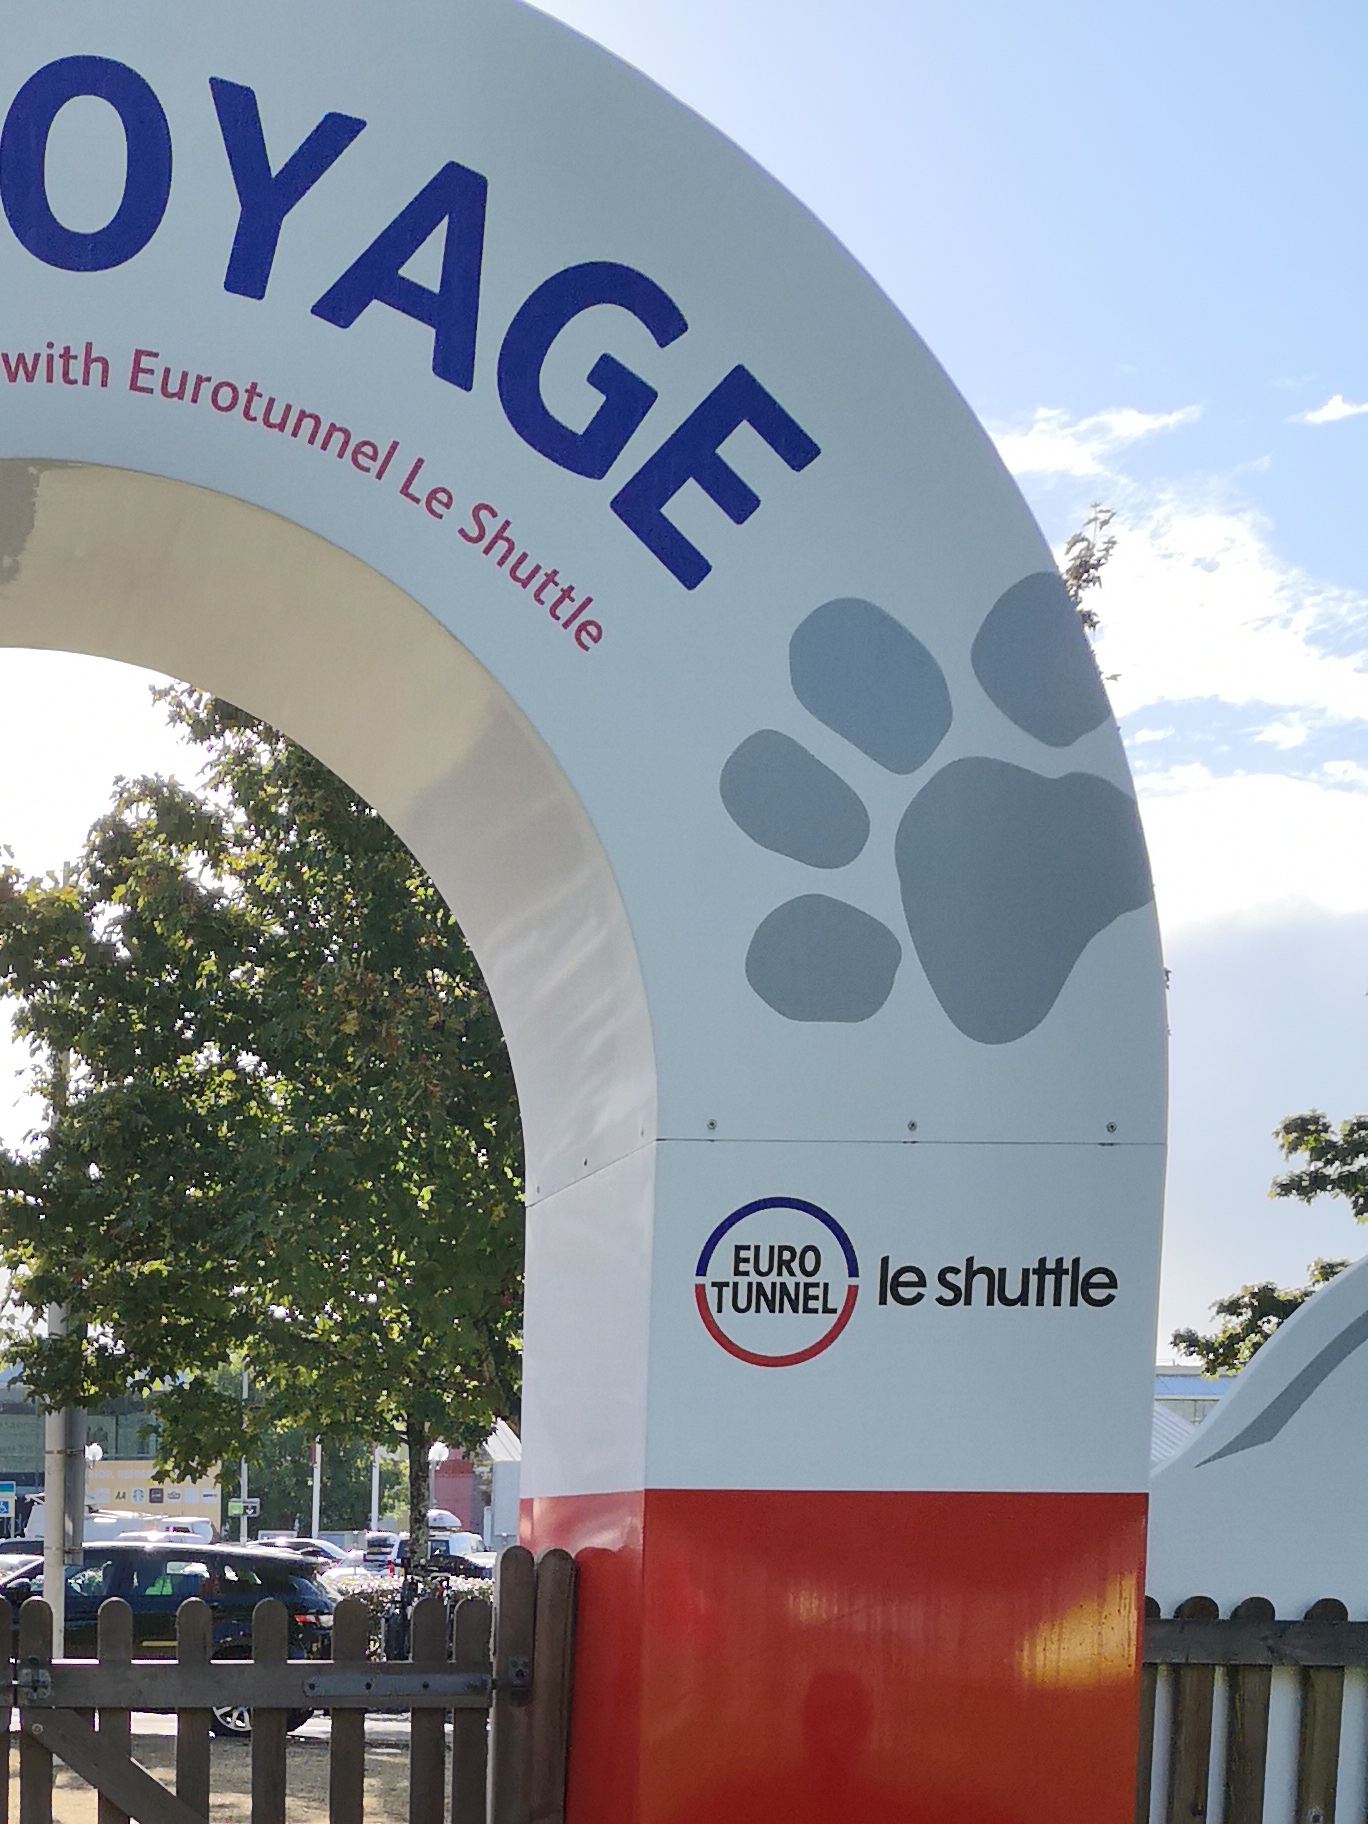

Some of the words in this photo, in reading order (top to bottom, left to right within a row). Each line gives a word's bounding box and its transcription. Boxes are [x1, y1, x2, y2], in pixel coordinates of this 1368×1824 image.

[1, 342, 110, 389] with
[128, 348, 400, 478] Eurotunnel
[399, 458, 455, 520] Le
[458, 502, 603, 652] Shuttle
[733, 1244, 822, 1278] EURO
[878, 1255, 928, 1307] le
[934, 1255, 1119, 1308] shuttle
[711, 1280, 838, 1315] TUNNEL
